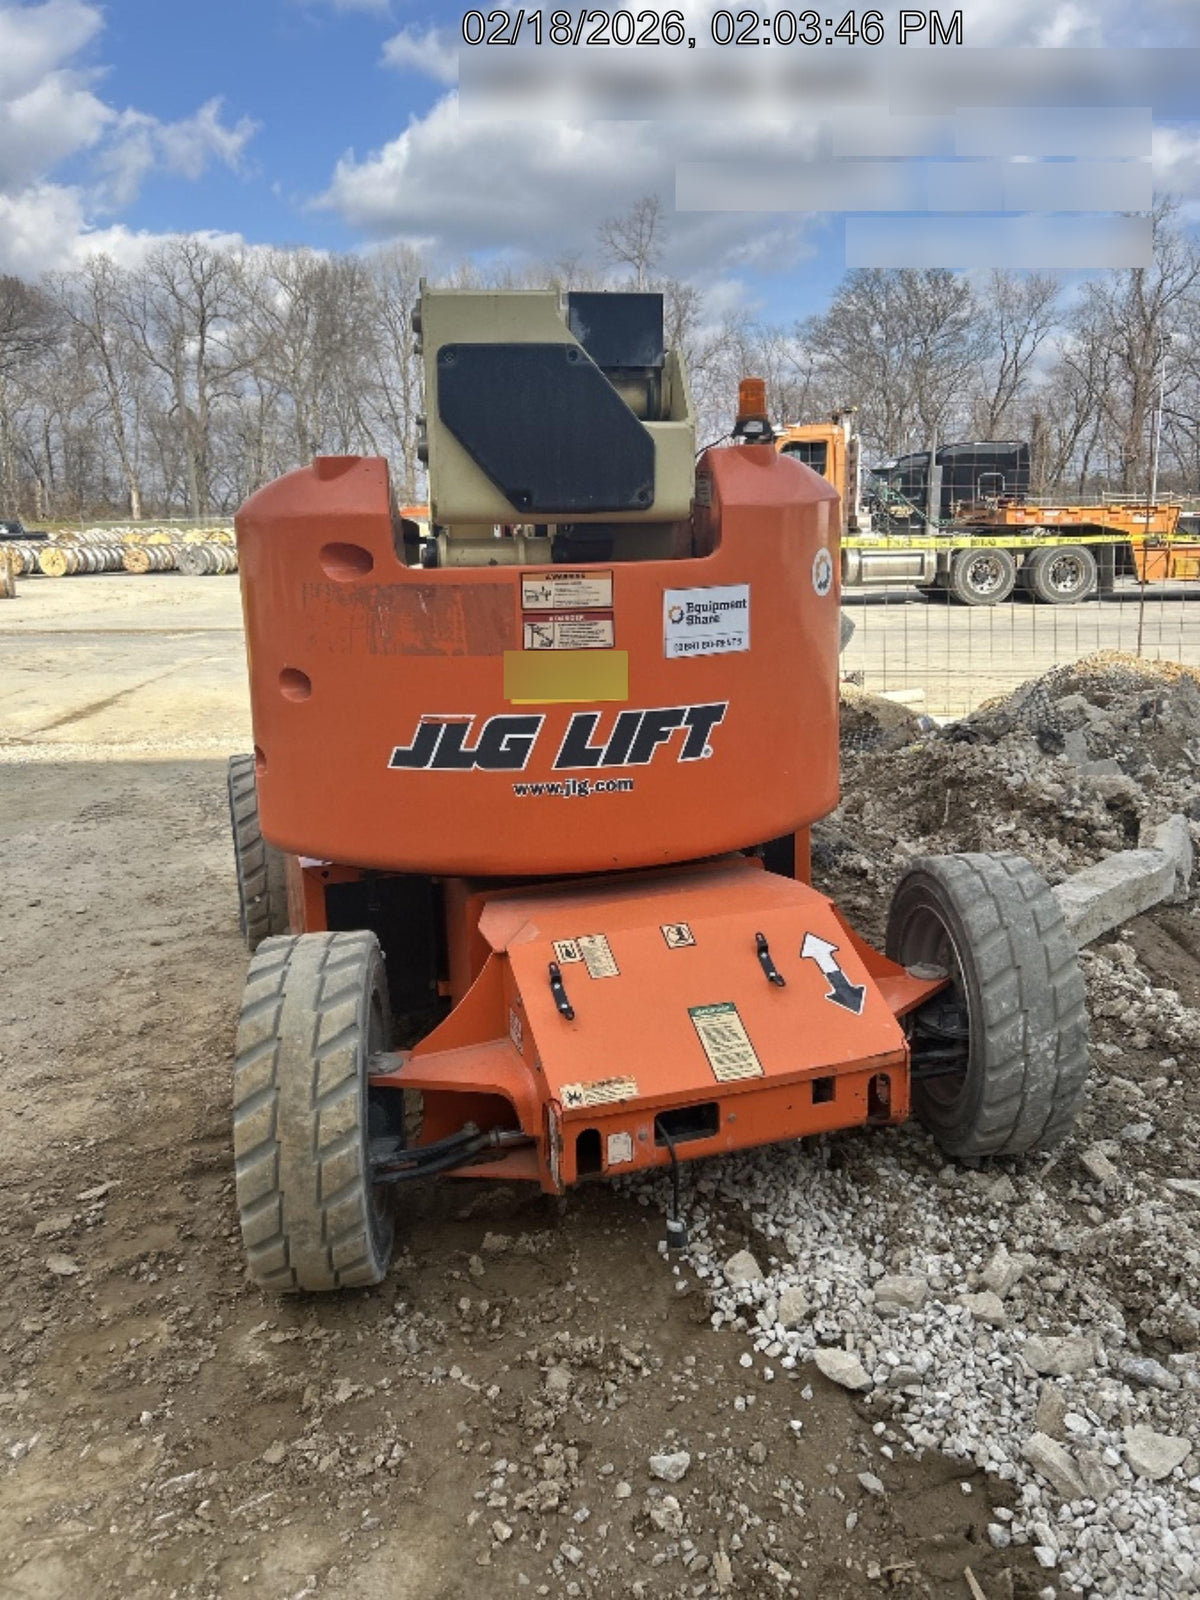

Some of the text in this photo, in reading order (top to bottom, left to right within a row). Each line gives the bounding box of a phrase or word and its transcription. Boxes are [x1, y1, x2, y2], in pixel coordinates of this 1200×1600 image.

[686, 598, 748, 614] Equipment
[686, 613, 721, 626] Share
[388, 700, 729, 773] JLG LIFT
[512, 778, 634, 799] www.jlg.com
